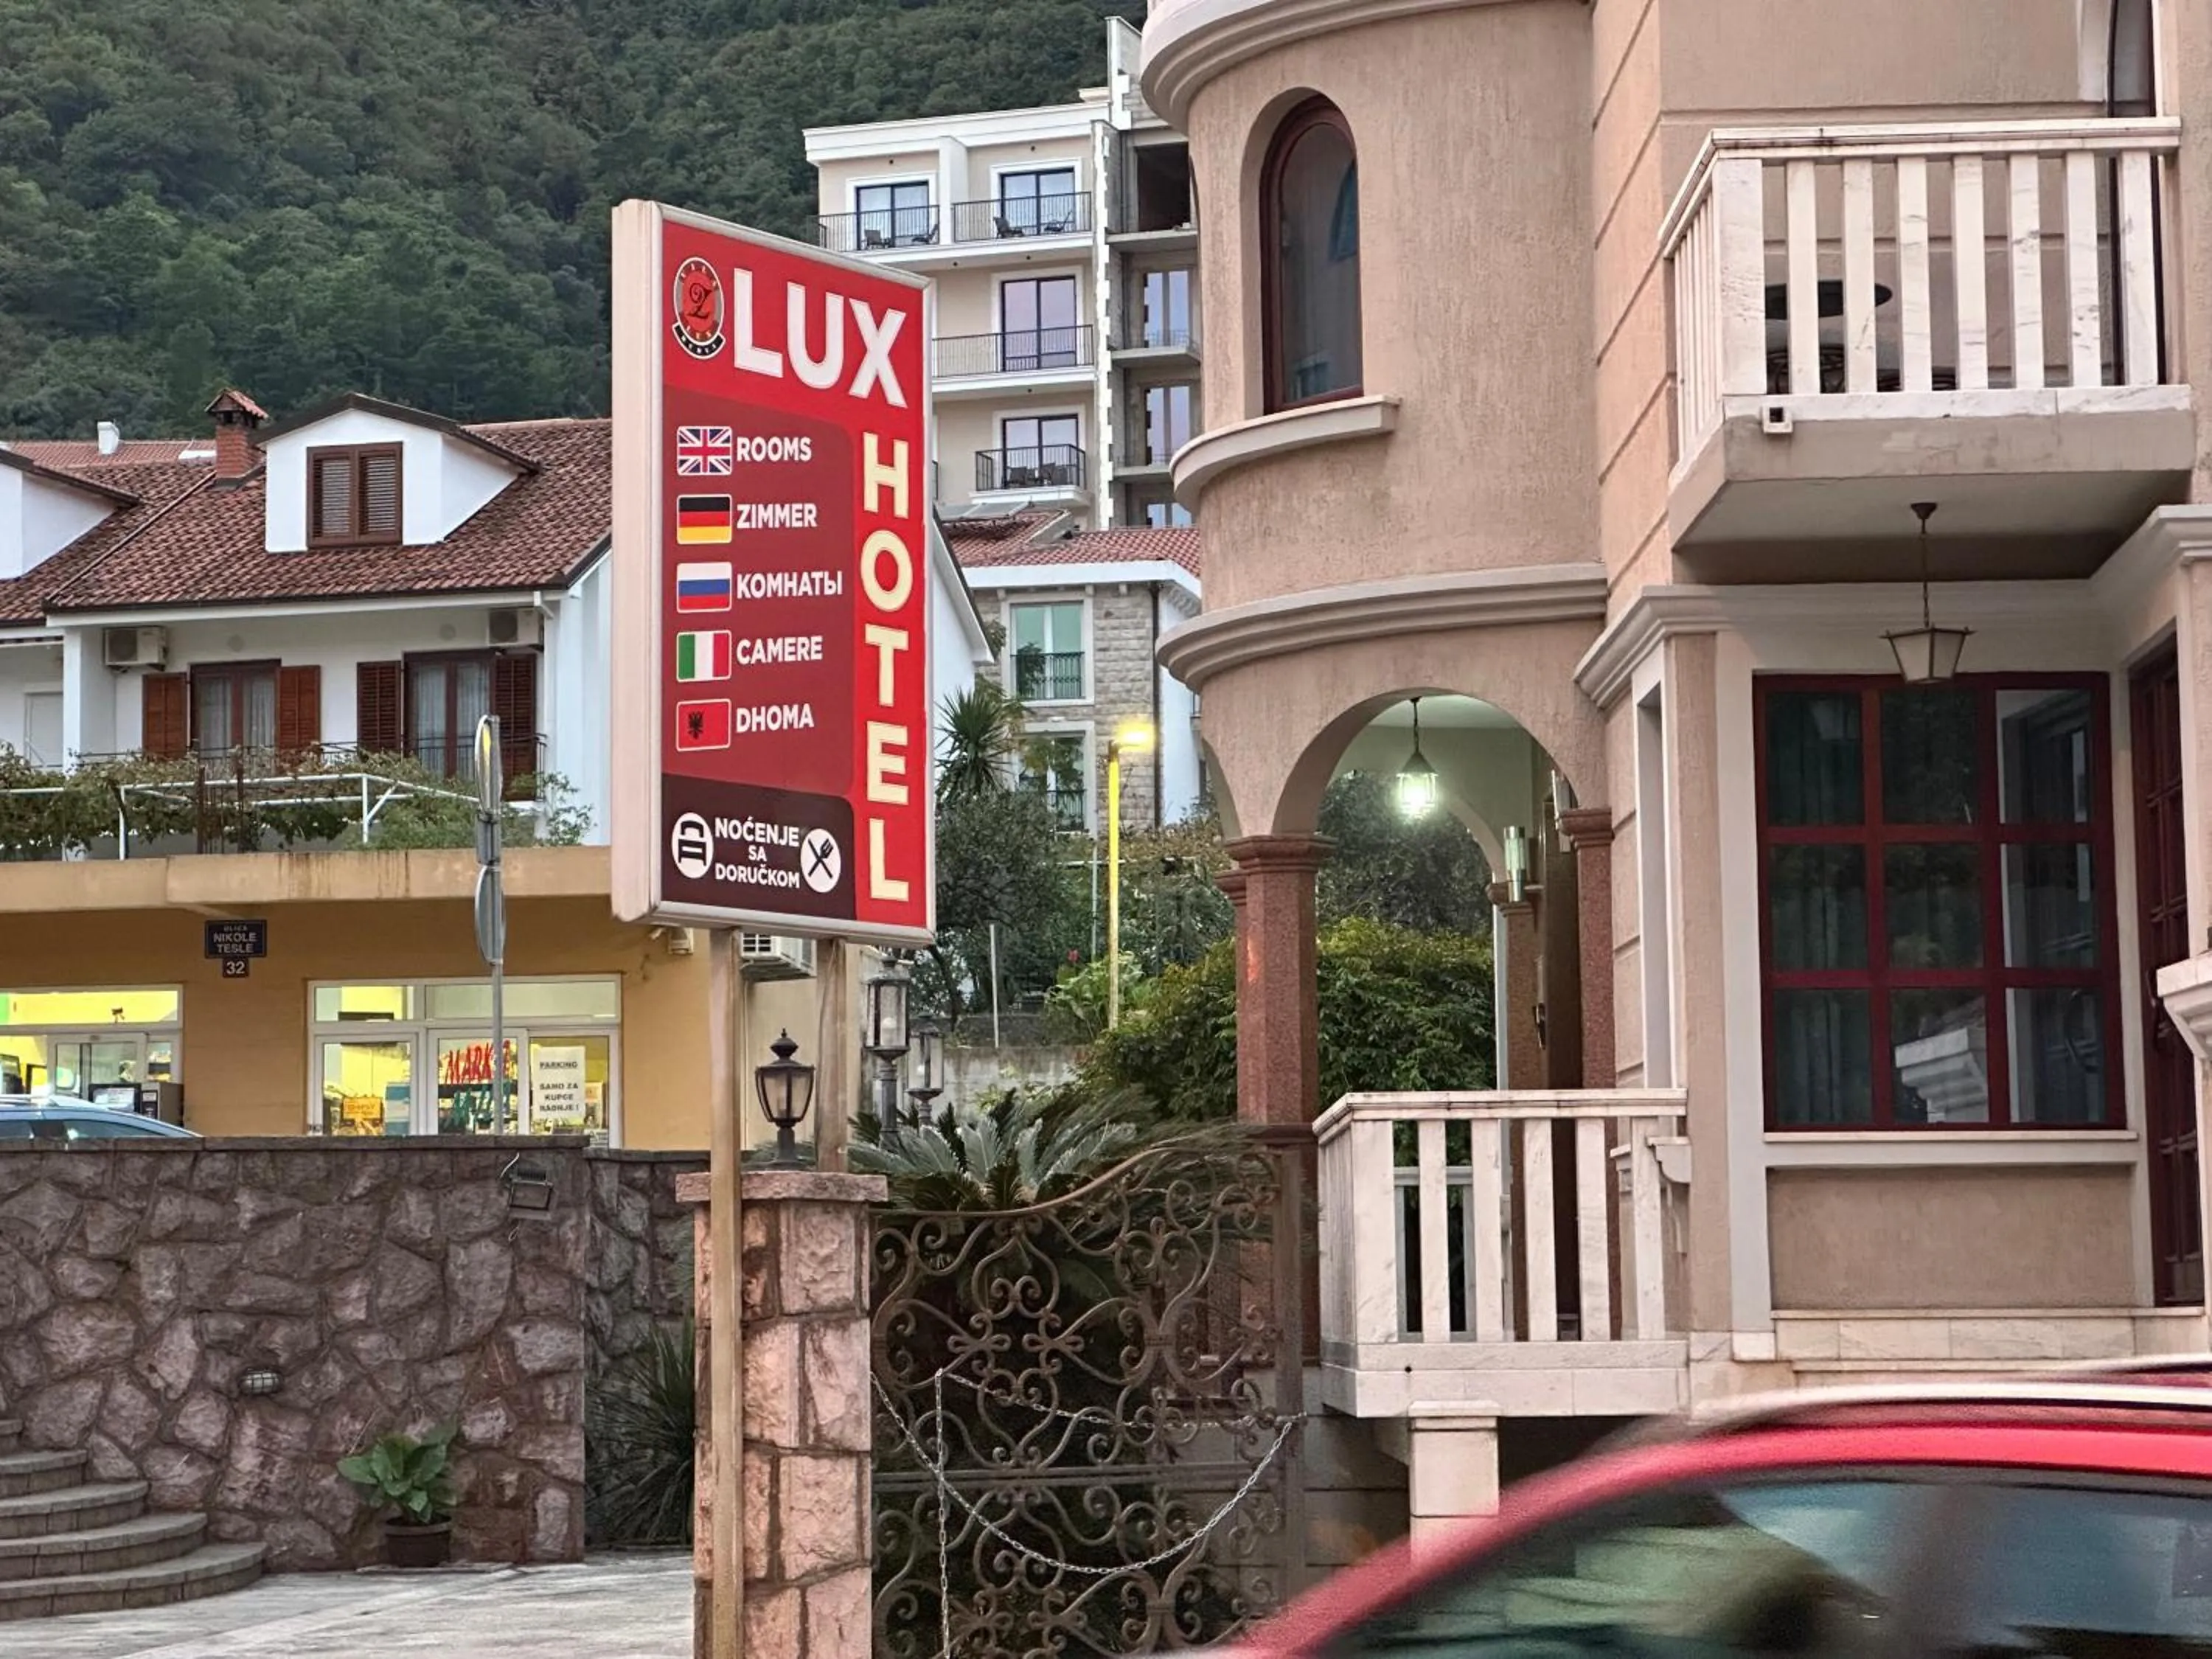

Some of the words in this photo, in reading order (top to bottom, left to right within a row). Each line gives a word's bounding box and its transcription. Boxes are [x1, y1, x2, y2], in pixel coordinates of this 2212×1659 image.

[734, 268, 908, 409] LUX
[737, 436, 812, 461] ROOMS
[737, 503, 817, 529] ZIMMER
[737, 571, 843, 599] КОМНАТЫ
[737, 636, 823, 665] CAMERE
[860, 431, 914, 902] HOTEL
[736, 703, 815, 733] DHOMA
[714, 816, 800, 847] NOĆENJE
[748, 846, 768, 862] SA
[714, 863, 800, 888] DORUČKOM
[213, 932, 257, 942] NIKOLE
[217, 943, 254, 953] TESLE
[226, 961, 246, 975] 32
